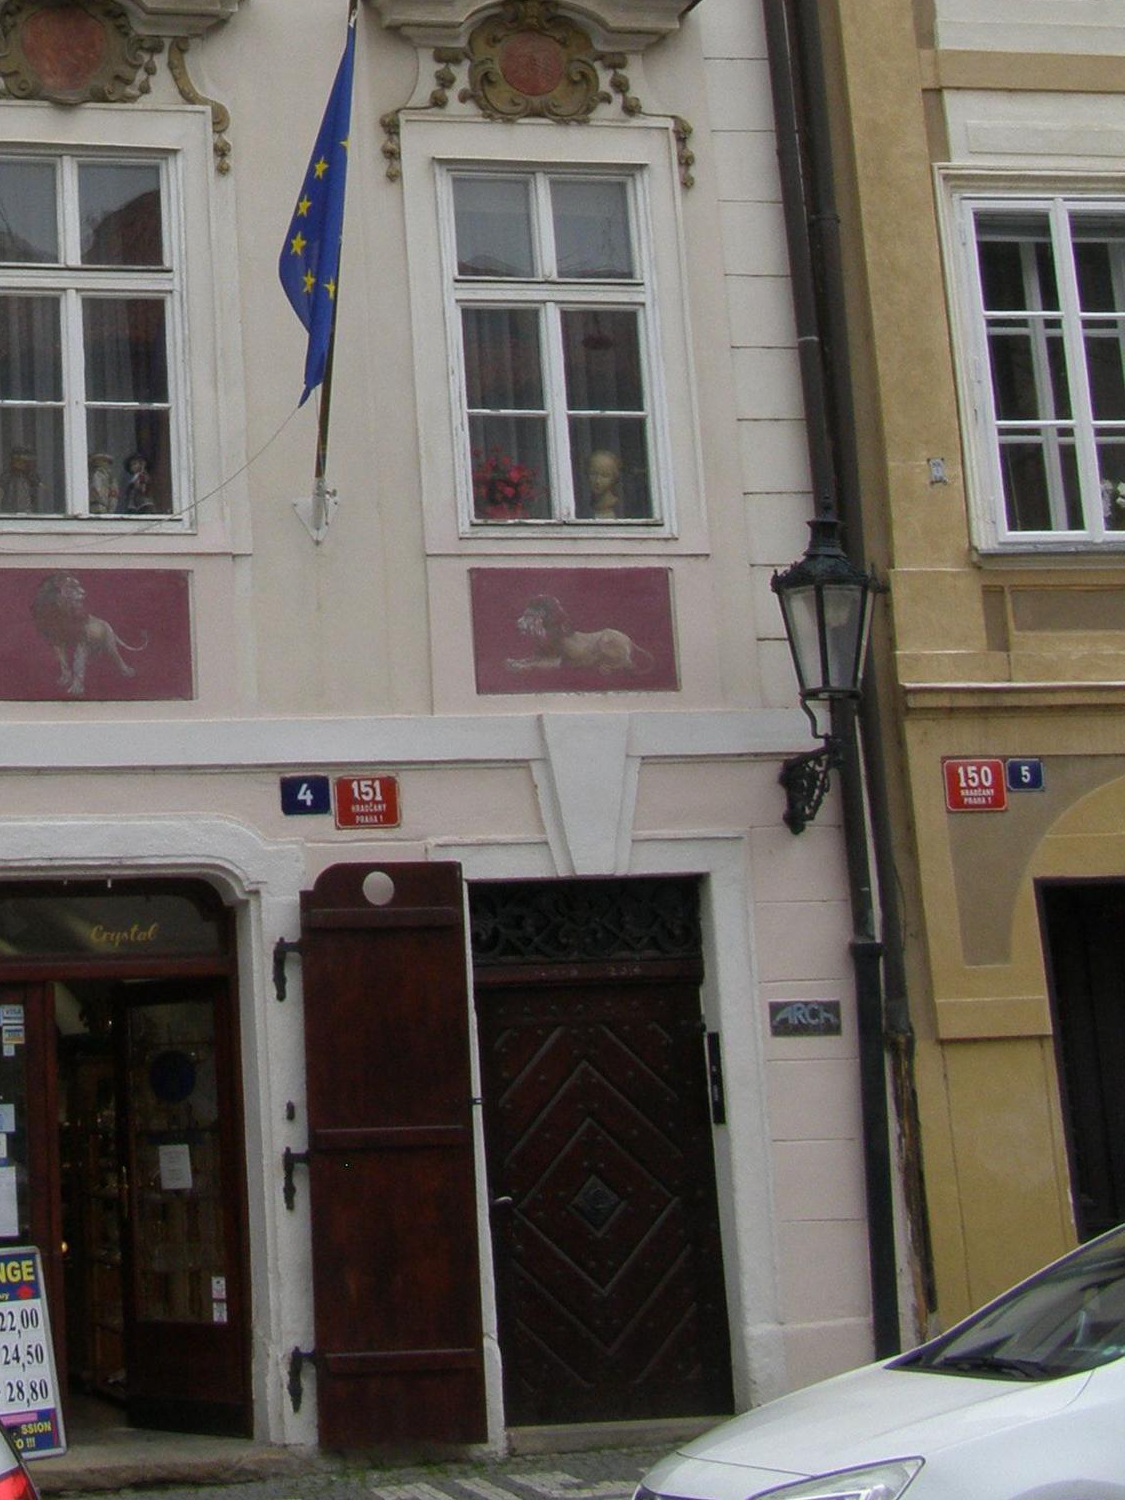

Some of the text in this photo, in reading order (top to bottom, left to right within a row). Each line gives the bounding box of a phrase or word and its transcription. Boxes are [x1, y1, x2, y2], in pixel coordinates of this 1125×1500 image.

[958, 765, 992, 787] 150
[1020, 765, 1031, 783] 5
[297, 783, 314, 806] 4
[351, 780, 383, 801] 151
[964, 797, 986, 805] PRAHA
[355, 815, 379, 823] PRAHA
[90, 921, 160, 948] Crystal
[2, 1344, 44, 1372] 24,50
[6, 1378, 49, 1408] 28,80
